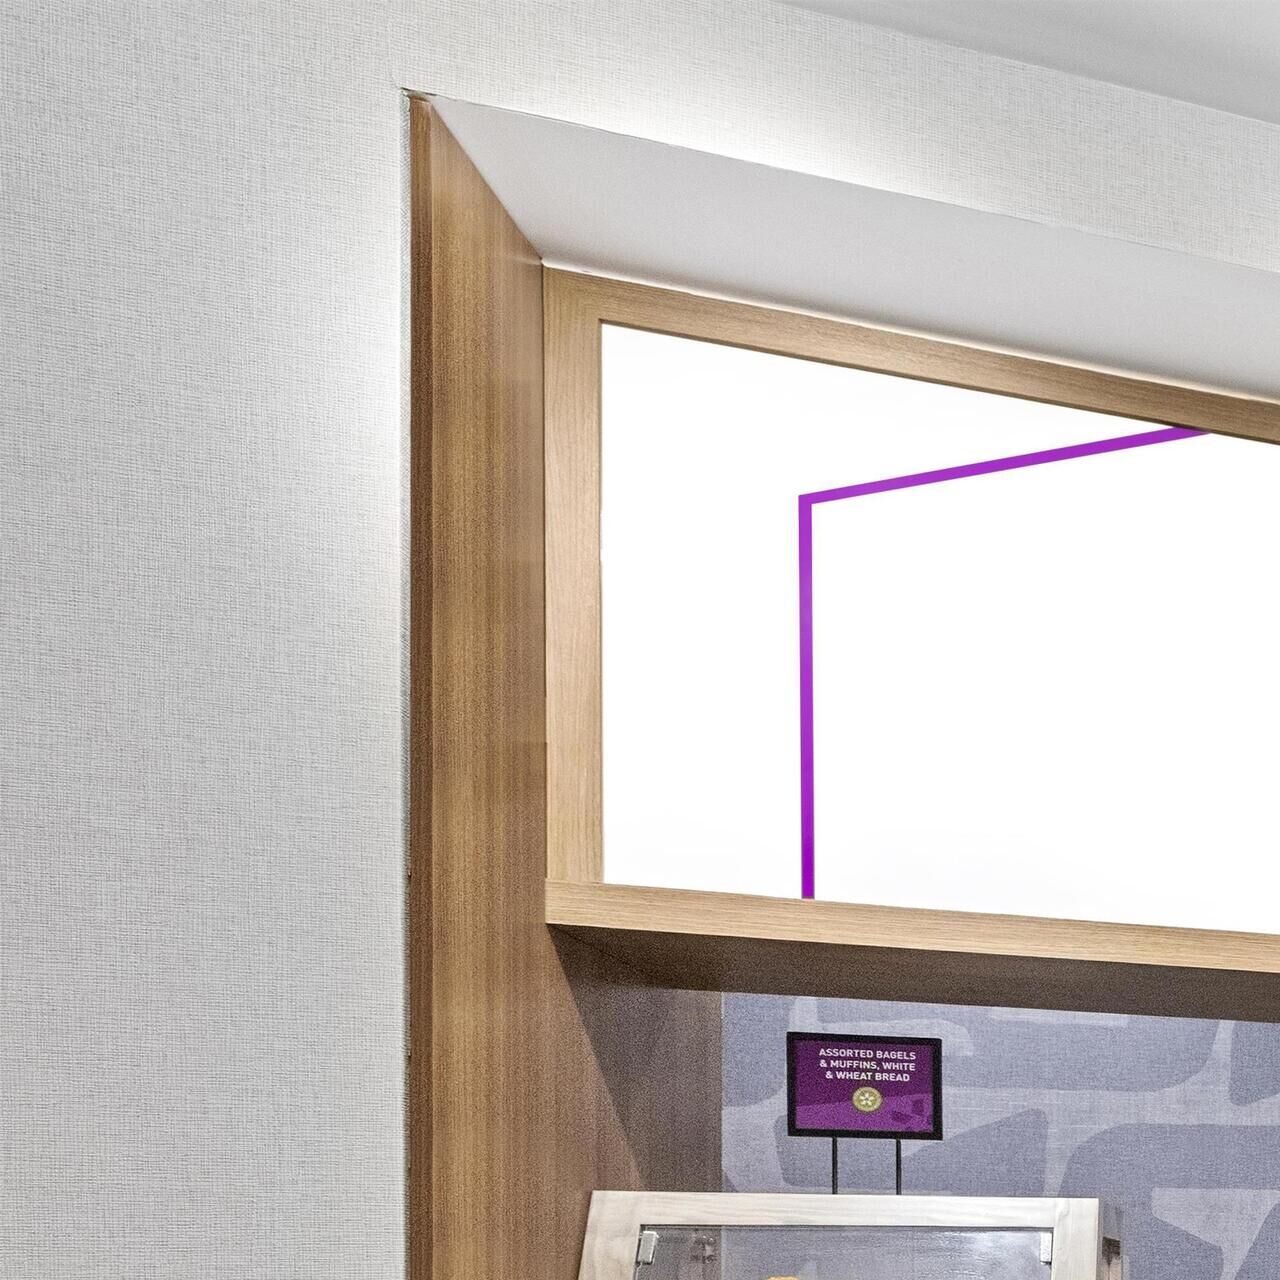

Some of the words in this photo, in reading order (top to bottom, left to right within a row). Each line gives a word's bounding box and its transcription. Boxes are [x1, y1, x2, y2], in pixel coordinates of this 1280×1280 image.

[819, 1048, 874, 1058] ASSORTED
[876, 1050, 917, 1060] BAGELS
[819, 1059, 828, 1068] &
[830, 1060, 880, 1071] MUFFINS,
[881, 1062, 916, 1071] WHITE
[825, 1070, 833, 1079] &
[835, 1071, 873, 1080] WHEAT
[875, 1072, 910, 1082] BREAD
